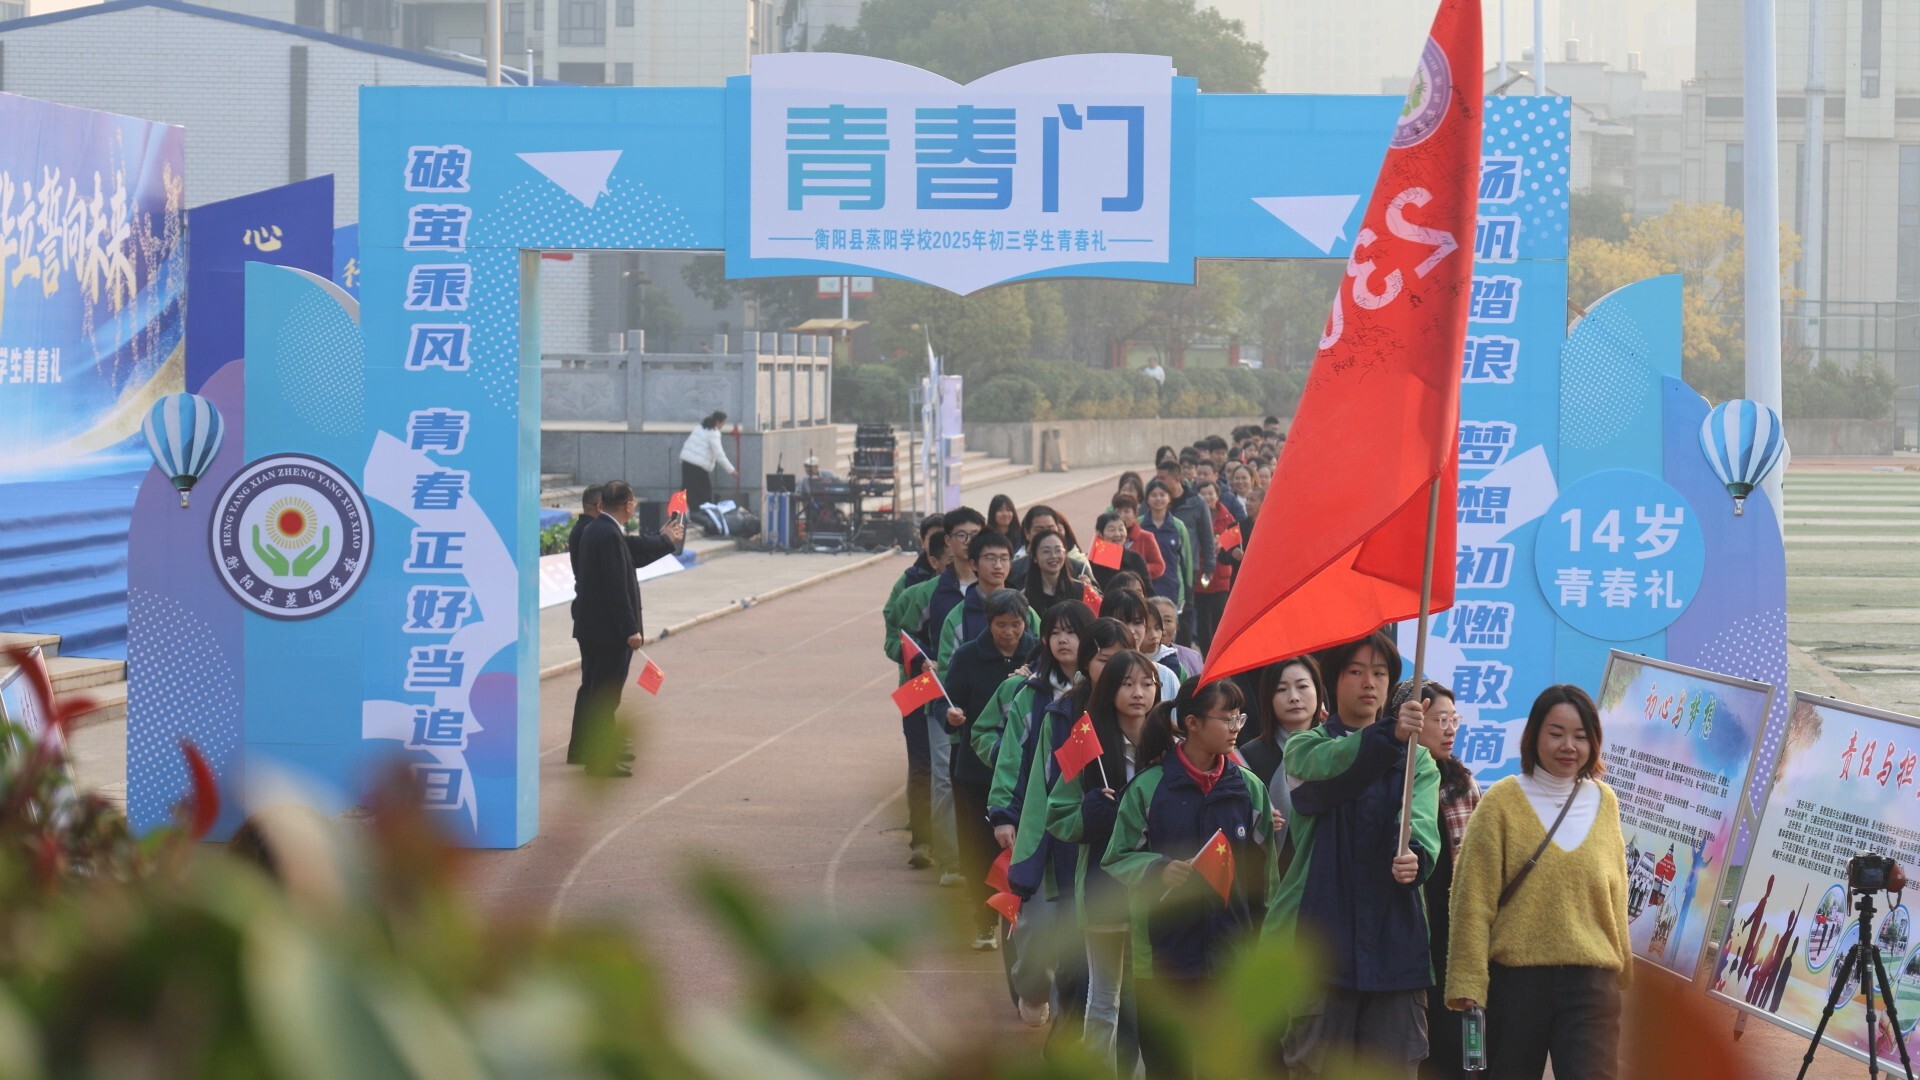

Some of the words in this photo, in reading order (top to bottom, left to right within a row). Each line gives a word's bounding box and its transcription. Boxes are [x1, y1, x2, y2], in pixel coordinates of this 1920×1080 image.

[785, 104, 1145, 212] 青春门
[243, 224, 283, 252] 心
[409, 150, 467, 367] 破茧乘风
[814, 228, 1107, 253] 衡阳县蒸阳学校2025年初三学生青春礼
[223, 514, 234, 547] HENG
[229, 487, 250, 514] YANG
[249, 470, 276, 489] XIAN
[277, 467, 316, 479] ZHENG
[317, 475, 343, 498] YANG
[341, 496, 358, 519] XUE
[351, 518, 361, 550] XIAO
[1560, 504, 1685, 560] 14岁
[408, 412, 467, 805] 青春正好当追日
[1449, 424, 1512, 788] 梦想初燃敢摘
[1554, 567, 1683, 609] 青春礼
[1644, 683, 1718, 740] 初心与梦想
[1839, 729, 1920, 800] 责任与担
